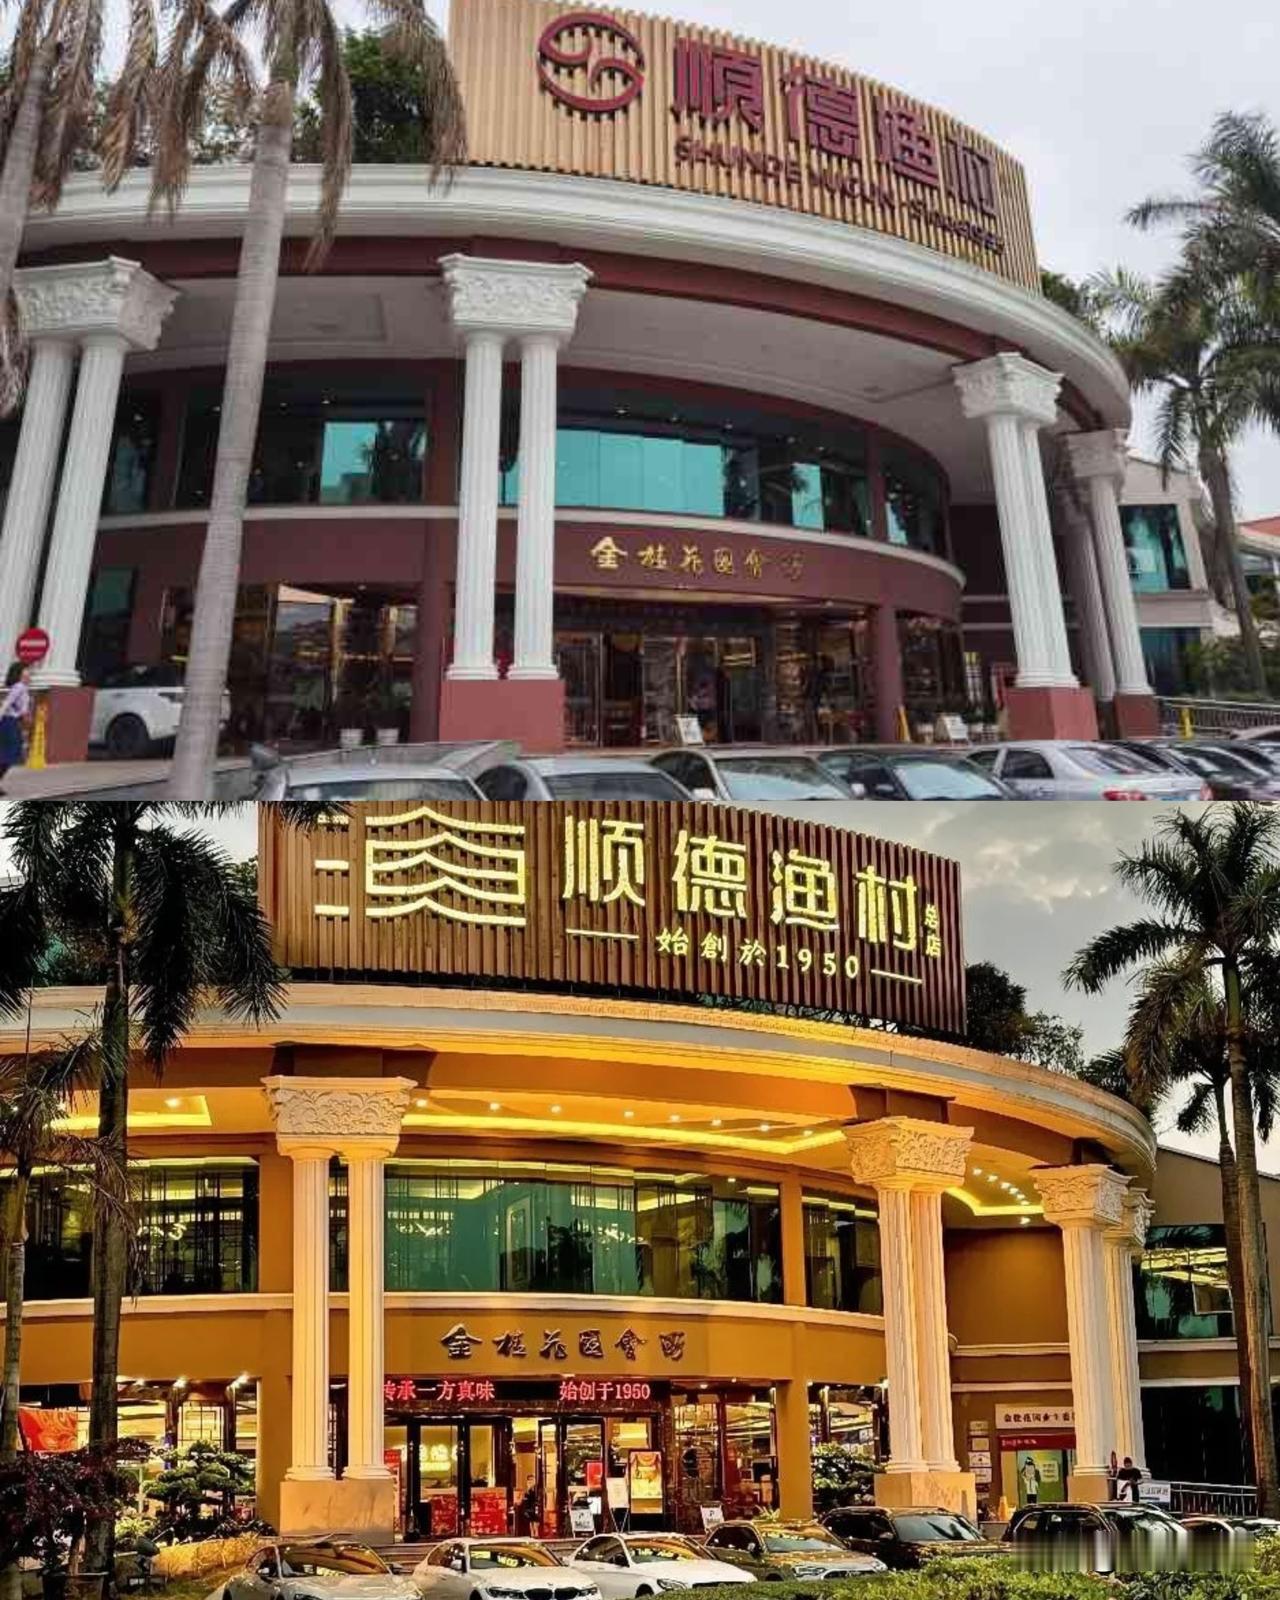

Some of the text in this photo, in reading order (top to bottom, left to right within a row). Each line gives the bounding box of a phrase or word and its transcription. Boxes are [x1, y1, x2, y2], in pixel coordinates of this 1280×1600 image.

[562, 815, 917, 951] 顺德渔村
[559, 1380, 652, 1401] 始创于1950
